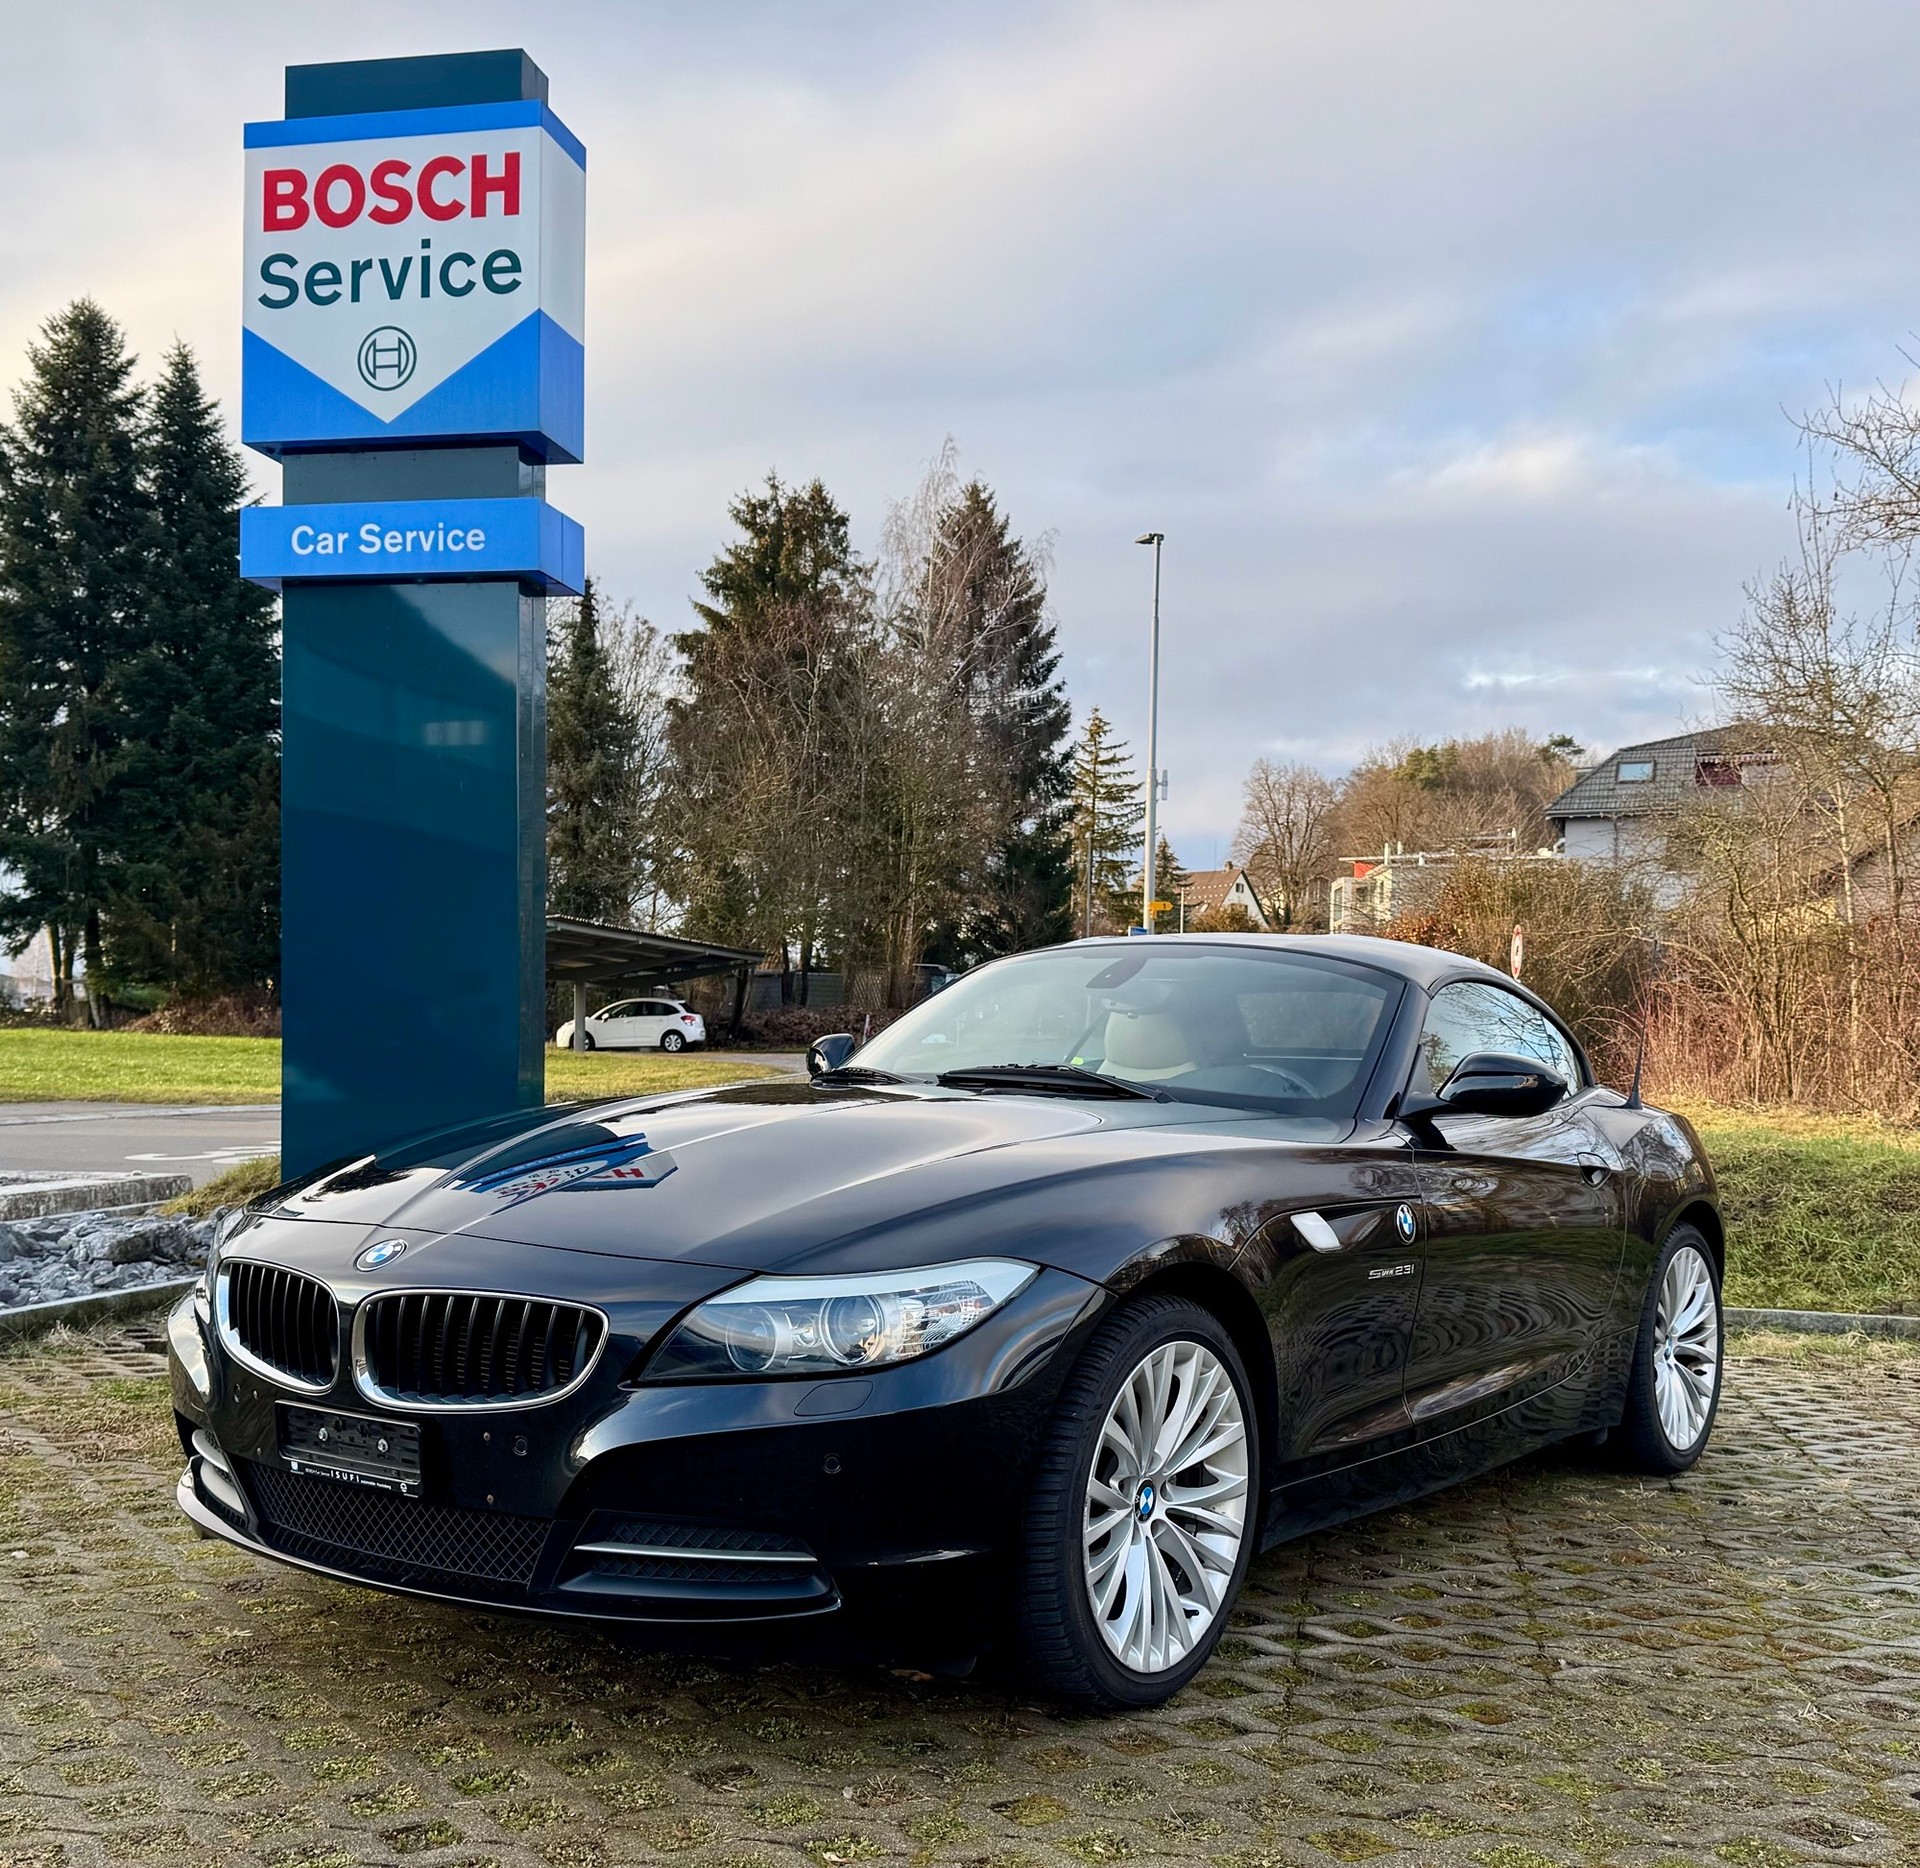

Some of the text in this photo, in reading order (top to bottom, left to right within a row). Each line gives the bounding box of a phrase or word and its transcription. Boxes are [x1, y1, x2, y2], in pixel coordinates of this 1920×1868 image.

[263, 152, 520, 232] BOSCH
[258, 238, 522, 309] Service
[291, 522, 485, 555] Car Service
[330, 1470, 360, 1483] ISUFI
